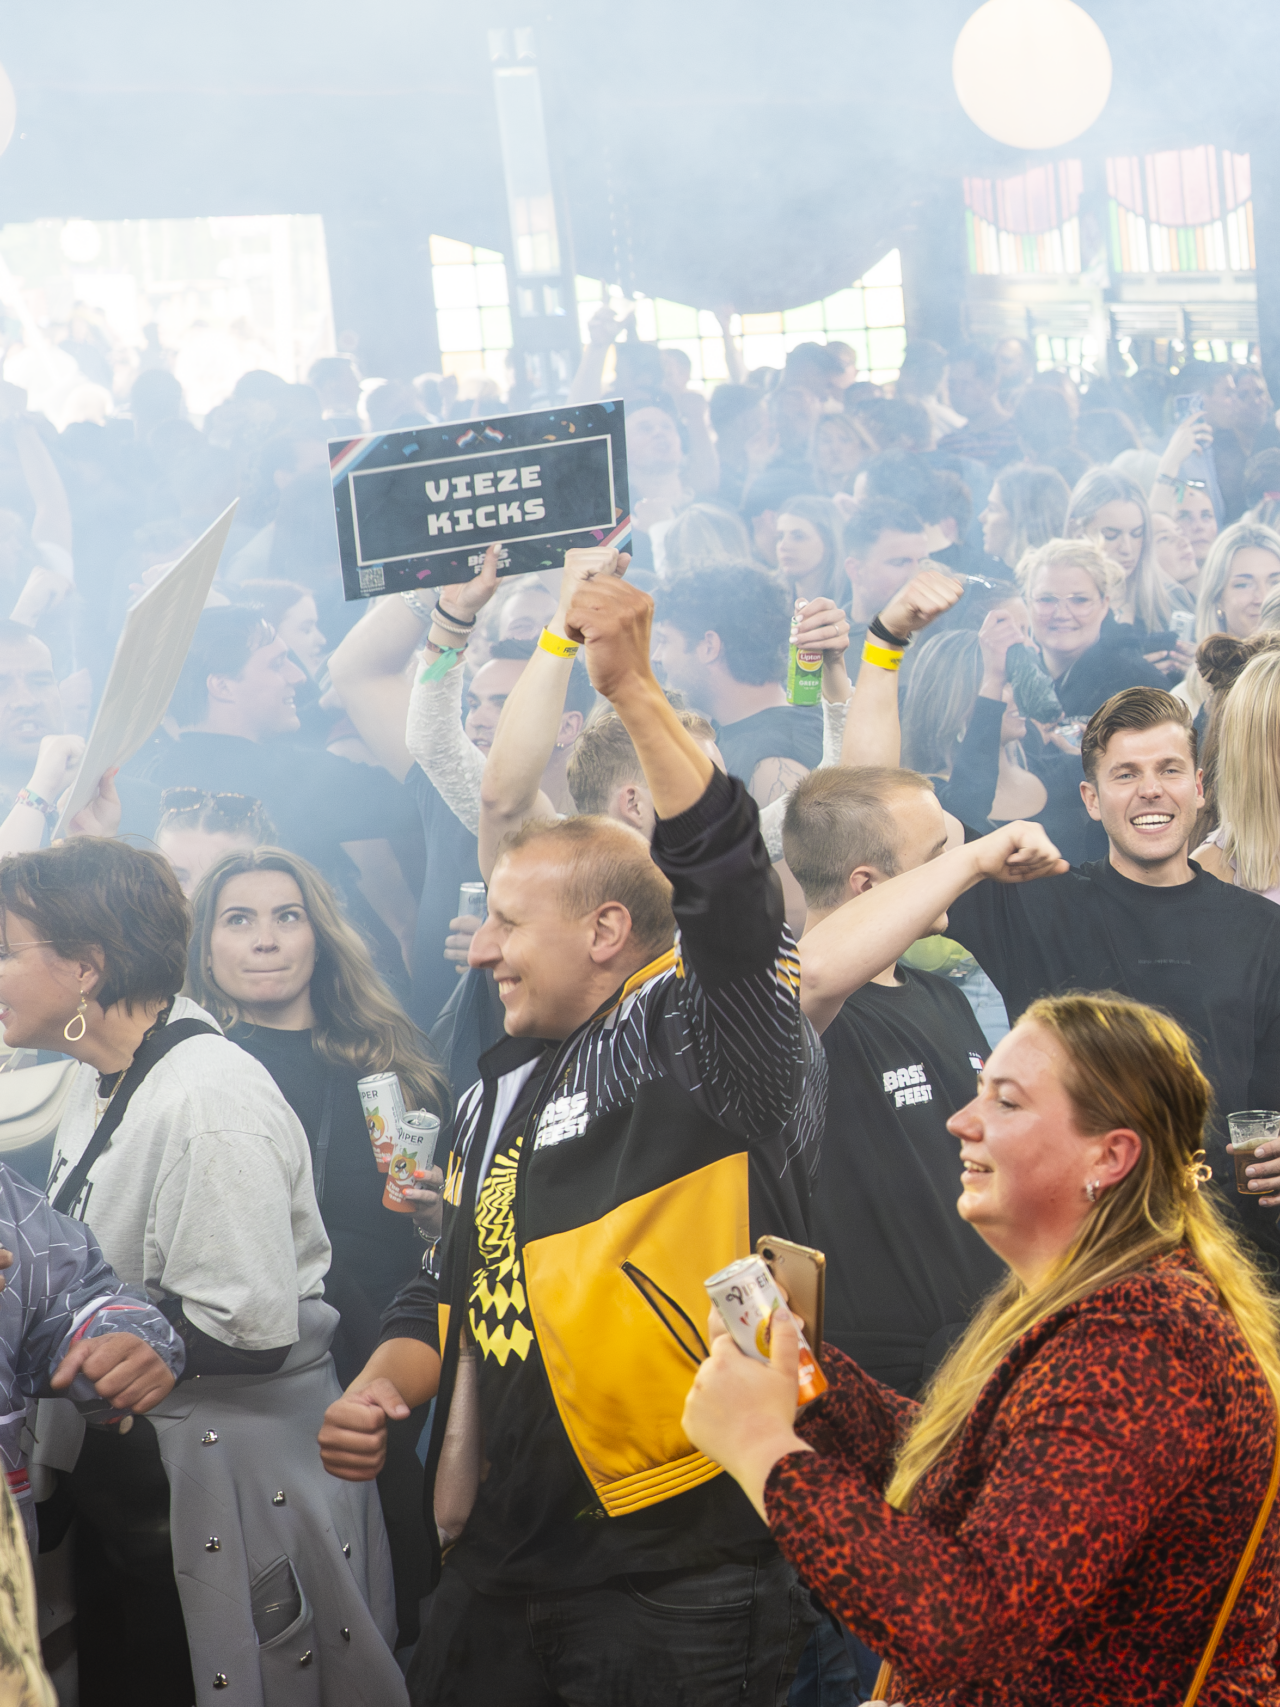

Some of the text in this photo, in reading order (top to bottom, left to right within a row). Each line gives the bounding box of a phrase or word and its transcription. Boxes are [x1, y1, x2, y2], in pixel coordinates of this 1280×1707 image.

[425, 465, 542, 502] VIEZE
[427, 498, 546, 536] KICKS
[467, 548, 509, 568] BAS
[800, 651, 821, 661] Lipton
[883, 1064, 927, 1093] BASS
[894, 1084, 933, 1108] FEEST
